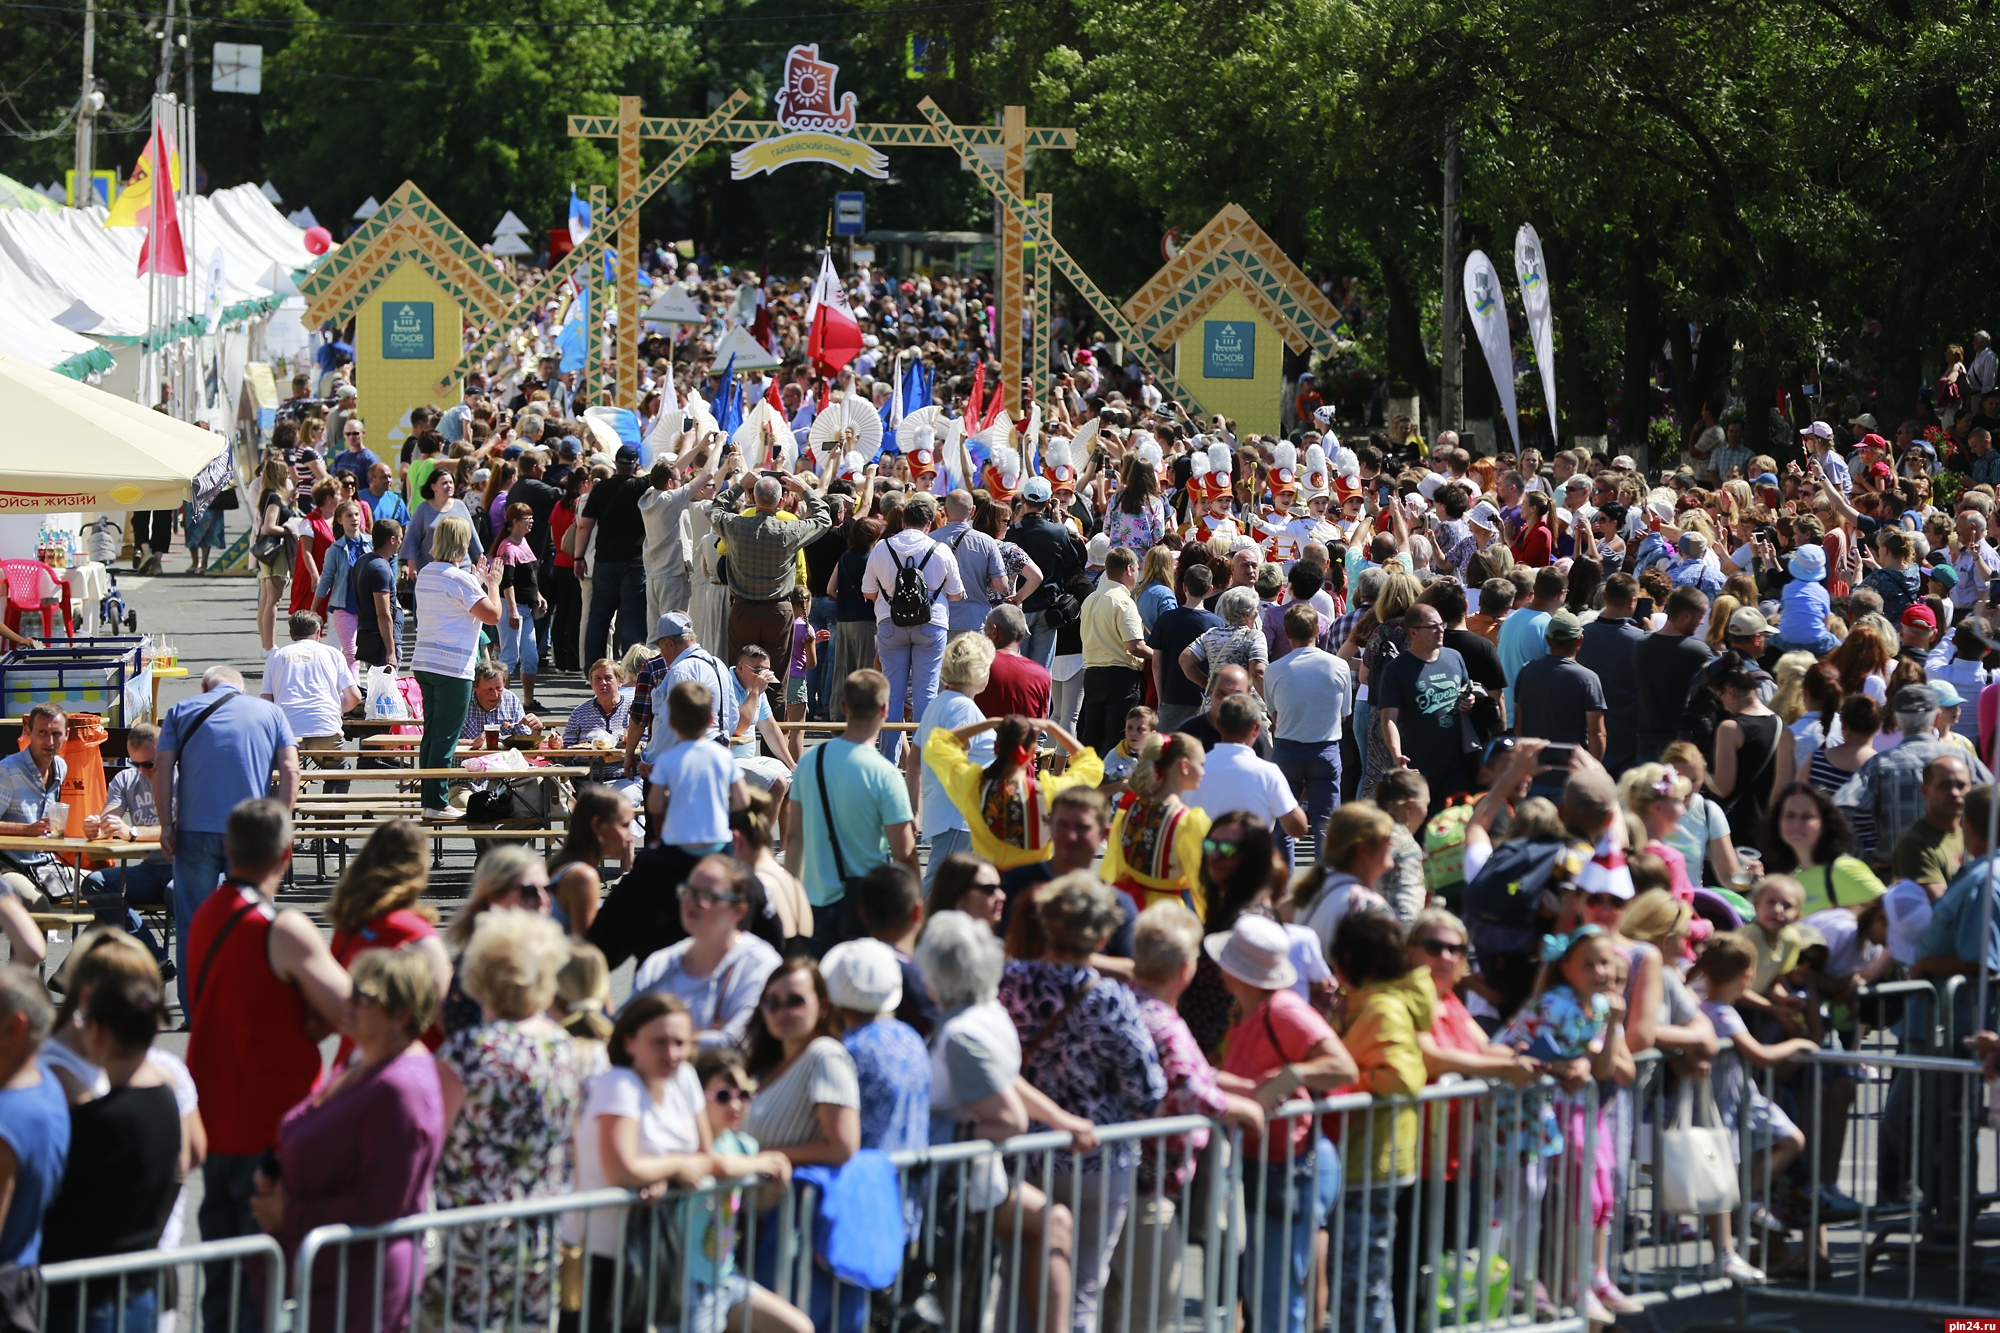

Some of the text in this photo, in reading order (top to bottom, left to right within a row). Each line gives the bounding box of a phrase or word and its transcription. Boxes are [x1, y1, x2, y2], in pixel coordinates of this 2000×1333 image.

[823, 143, 853, 159] РЫНОК
[390, 333, 424, 343] ПСКОВ
[1212, 352, 1245, 363] ПСКОВ
[283, 650, 318, 666] HOST
